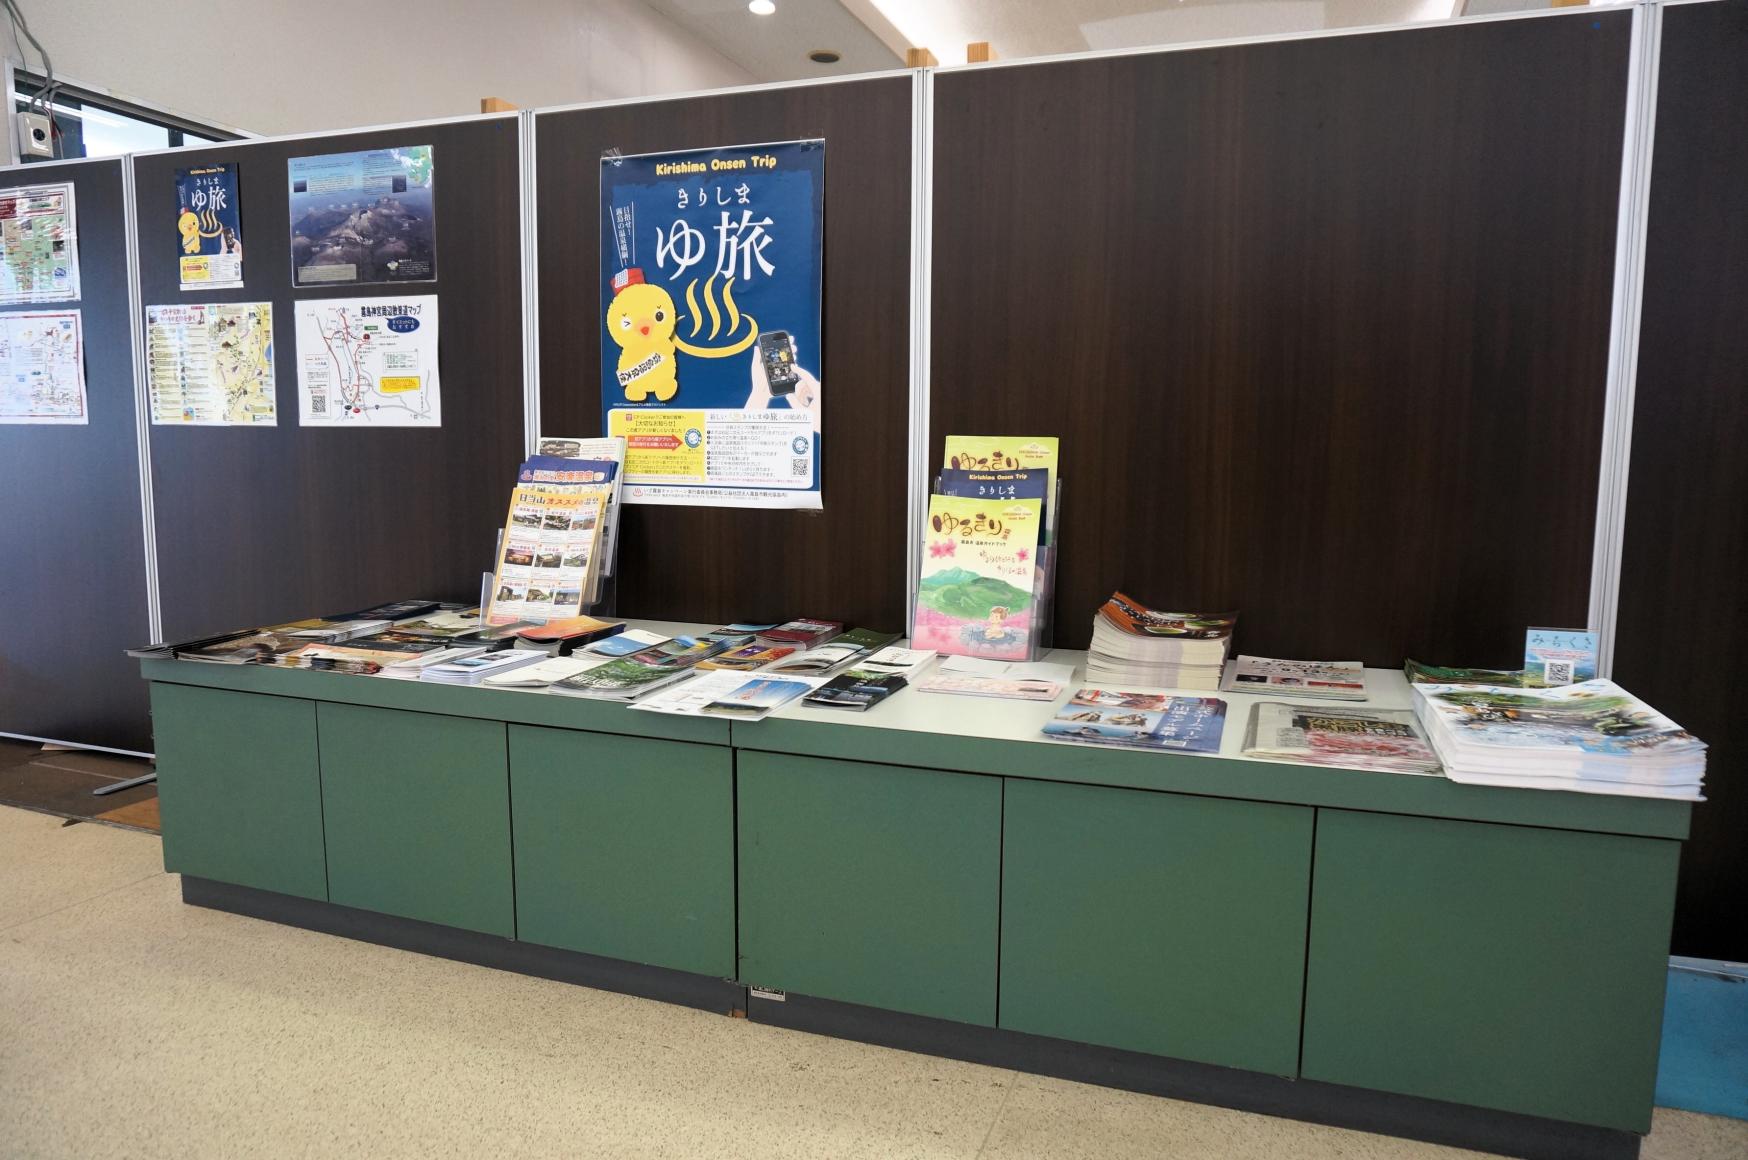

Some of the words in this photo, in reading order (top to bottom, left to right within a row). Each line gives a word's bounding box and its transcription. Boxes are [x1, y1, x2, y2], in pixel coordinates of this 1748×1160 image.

[655, 162, 707, 176] Kirishima
[711, 159, 747, 170] Onsen
[751, 155, 777, 169] Trip
[191, 185, 227, 211] ゆ旅
[677, 182, 751, 209] きりしま
[655, 209, 776, 281] ゆ旅
[979, 485, 1016, 495] きりしま
